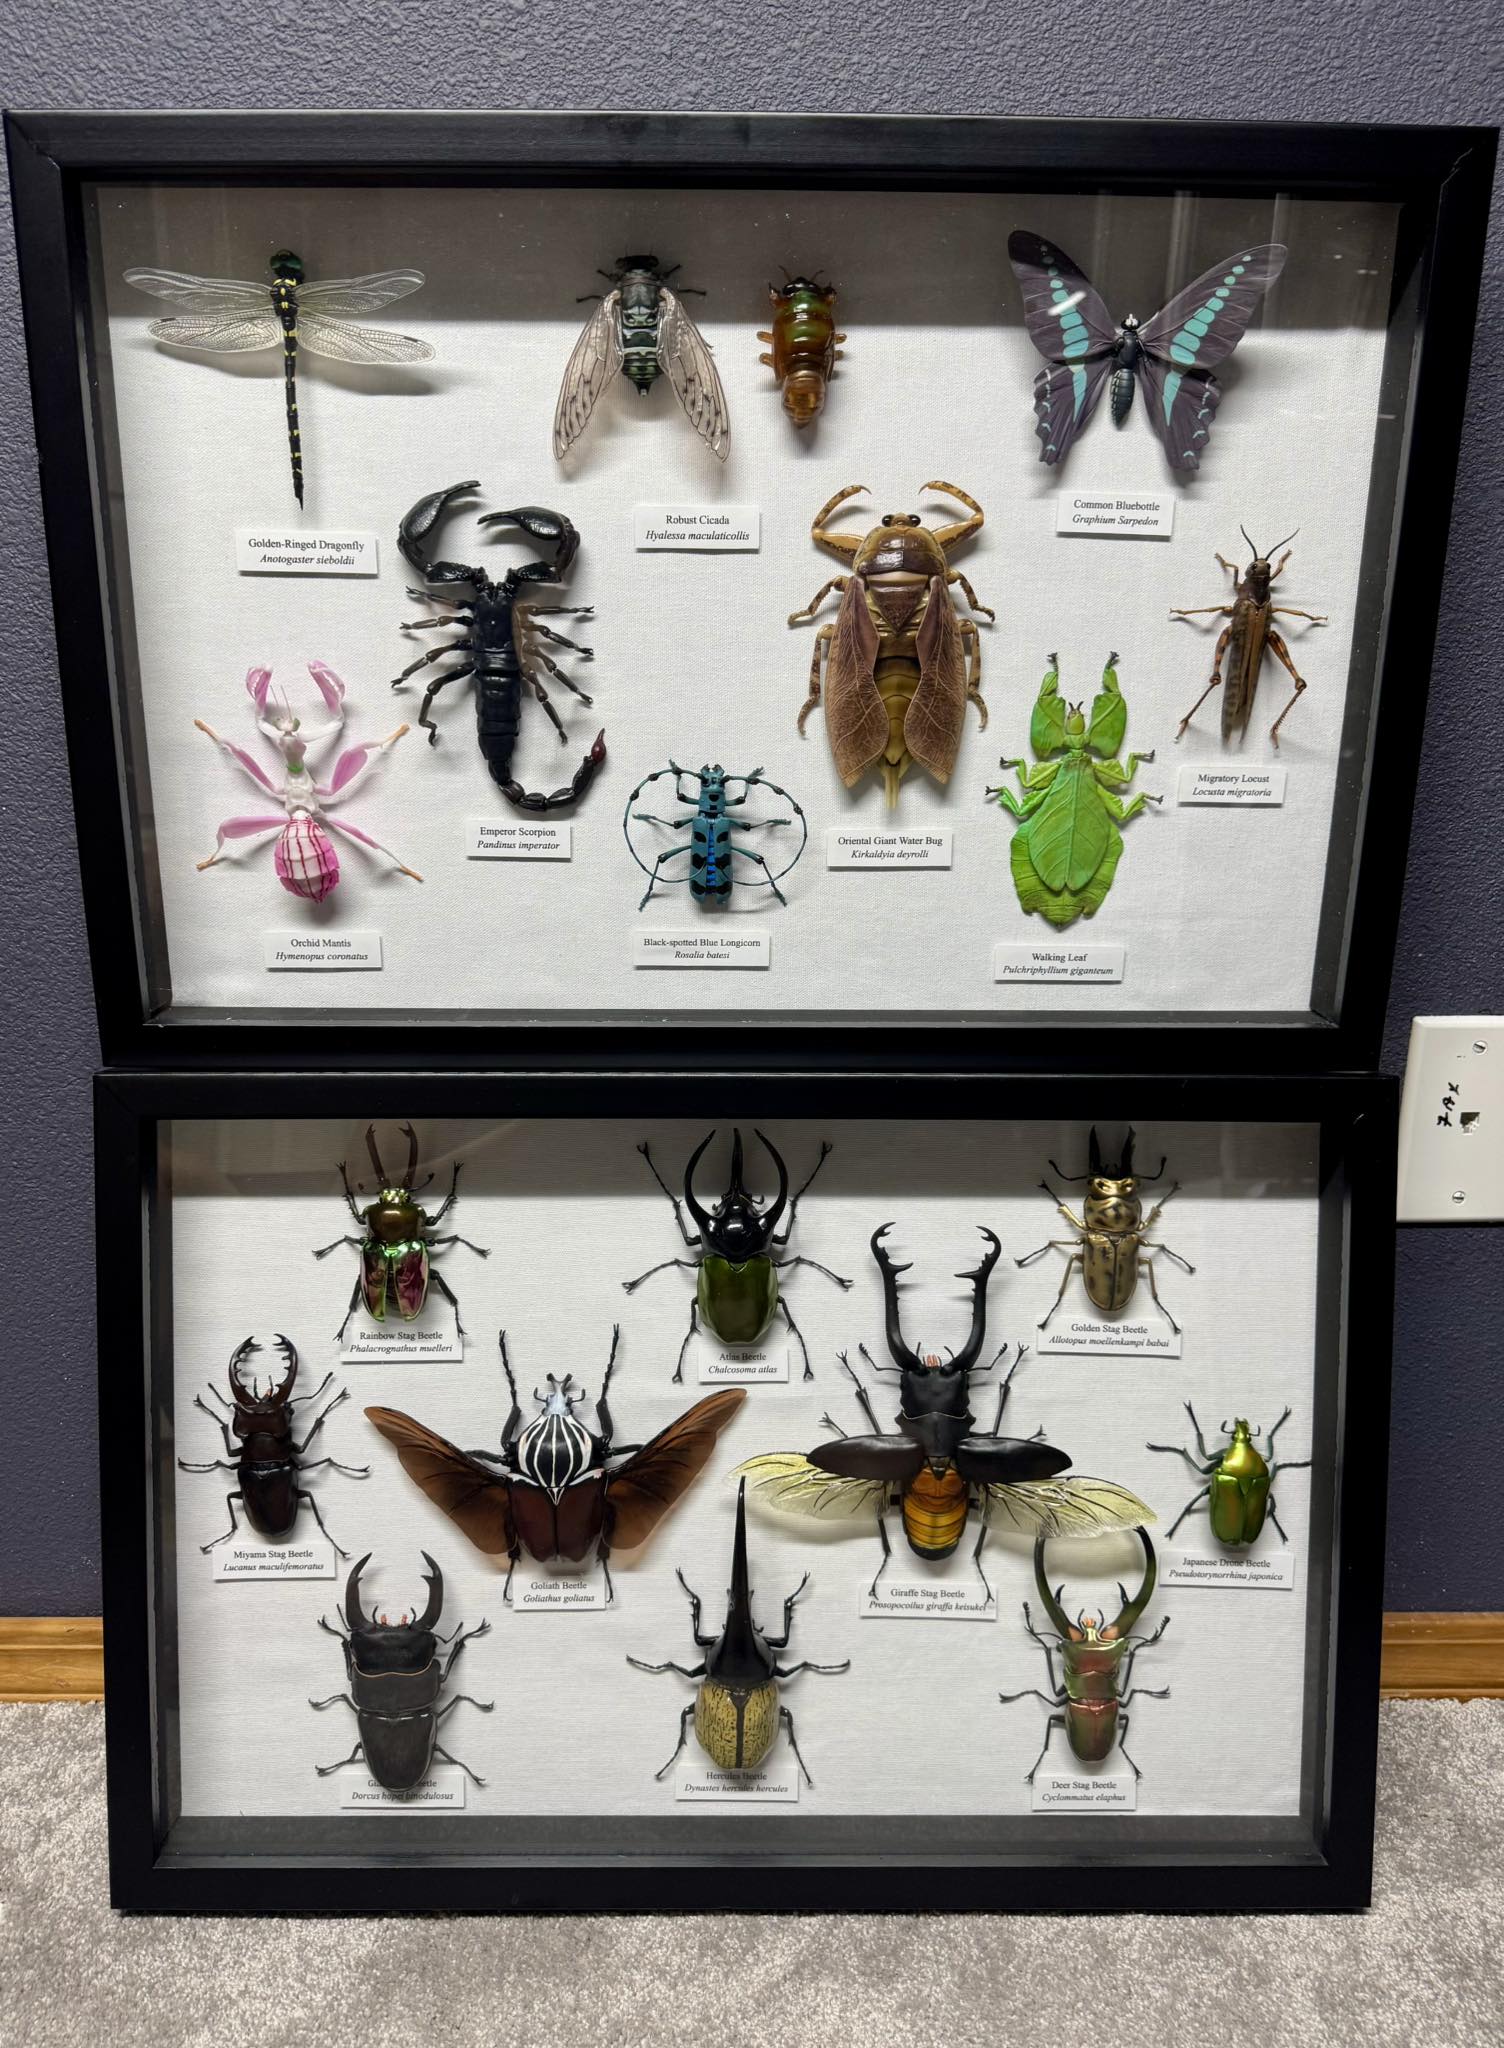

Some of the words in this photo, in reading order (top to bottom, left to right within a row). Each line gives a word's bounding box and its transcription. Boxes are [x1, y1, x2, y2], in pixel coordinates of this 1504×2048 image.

[1074, 500, 1113, 510] Common
[1116, 500, 1160, 511] Bluebottle
[666, 515, 697, 525] Robust
[699, 515, 730, 525] Cicada
[1072, 514, 1116, 526] Graphium
[1118, 515, 1158, 527] Sarpedon
[646, 530, 686, 541] Hyalessa
[688, 530, 749, 541] maculaticollis
[248, 539, 317, 550] Golden-Ringed
[319, 540, 364, 552] Dragonfly
[260, 554, 314, 566] Anotogaster
[316, 554, 355, 565] sieboldii
[1198, 774, 1239, 784] Migratory
[1241, 774, 1269, 783] Locust
[1192, 788, 1225, 796] Locusta
[1227, 788, 1272, 798] migratoria
[480, 828, 517, 838] Emperor
[519, 828, 556, 838] Scorpion
[477, 841, 516, 850] Pandinus
[518, 841, 560, 851] imperator
[838, 837, 872, 845] Oriental
[874, 837, 897, 845] Giant
[898, 837, 923, 846] Water
[926, 837, 943, 848] Bug
[897, 850, 928, 860] deyrolli
[290, 939, 320, 948] Orchid
[323, 939, 351, 948] Mantis
[644, 938, 697, 948] Black-spotted
[700, 939, 718, 947] Blue
[720, 939, 761, 949] Longicorn
[276, 952, 325, 962] Hymenopus
[327, 953, 368, 961] coronatus
[675, 951, 704, 959] Rosalia
[707, 951, 730, 959] batesi
[1032, 953, 1066, 963] Walking
[1068, 954, 1088, 962] Leaf
[1003, 966, 1068, 976] Pulchriphyllium
[1070, 967, 1113, 976] giganteum
[1071, 1324, 1101, 1333] Golden
[1103, 1324, 1121, 1334] Stag
[1123, 1325, 1148, 1333] Beetle
[360, 1332, 396, 1340] Rainbow
[398, 1332, 416, 1342] Stag
[418, 1332, 443, 1340] Beetle
[1049, 1336, 1087, 1346] Allotopus
[1147, 1339, 1169, 1347] babai
[350, 1345, 417, 1354] Phalacrognathus
[420, 1344, 452, 1353] muelleri
[719, 1353, 740, 1361] Atlas
[742, 1353, 767, 1361] Beetle
[708, 1366, 756, 1374] Chalcosoma
[759, 1366, 777, 1374] atlas
[234, 1550, 266, 1560] Miyama
[268, 1550, 286, 1559] Stag
[288, 1550, 313, 1558] Beetle
[223, 1563, 256, 1571] Lucanus
[258, 1562, 324, 1572] maculifemoratus
[1183, 1558, 1217, 1569] Japanese
[1219, 1559, 1243, 1567] Drone
[1246, 1559, 1271, 1568] Beetle
[1248, 1572, 1283, 1581] japonica
[531, 1582, 561, 1590] Goliath
[563, 1582, 587, 1590] Beetle
[523, 1594, 562, 1603] Goliathus
[564, 1594, 595, 1604] goliatus
[891, 1589, 918, 1598] Giraffe
[920, 1589, 938, 1599] Stag
[940, 1590, 965, 1598] Beetle
[926, 1602, 953, 1613] giraffa
[706, 1772, 741, 1780] Hercules
[743, 1772, 767, 1780] Beetle
[684, 1784, 719, 1794] Dynastes
[722, 1784, 753, 1793] hercules
[756, 1784, 788, 1793] hercules
[1052, 1781, 1070, 1789] Deer
[1072, 1781, 1090, 1791] Stag
[1092, 1781, 1117, 1789] Beetle
[352, 1792, 380, 1800] Dorcus
[1096, 1794, 1126, 1803] elaphus
